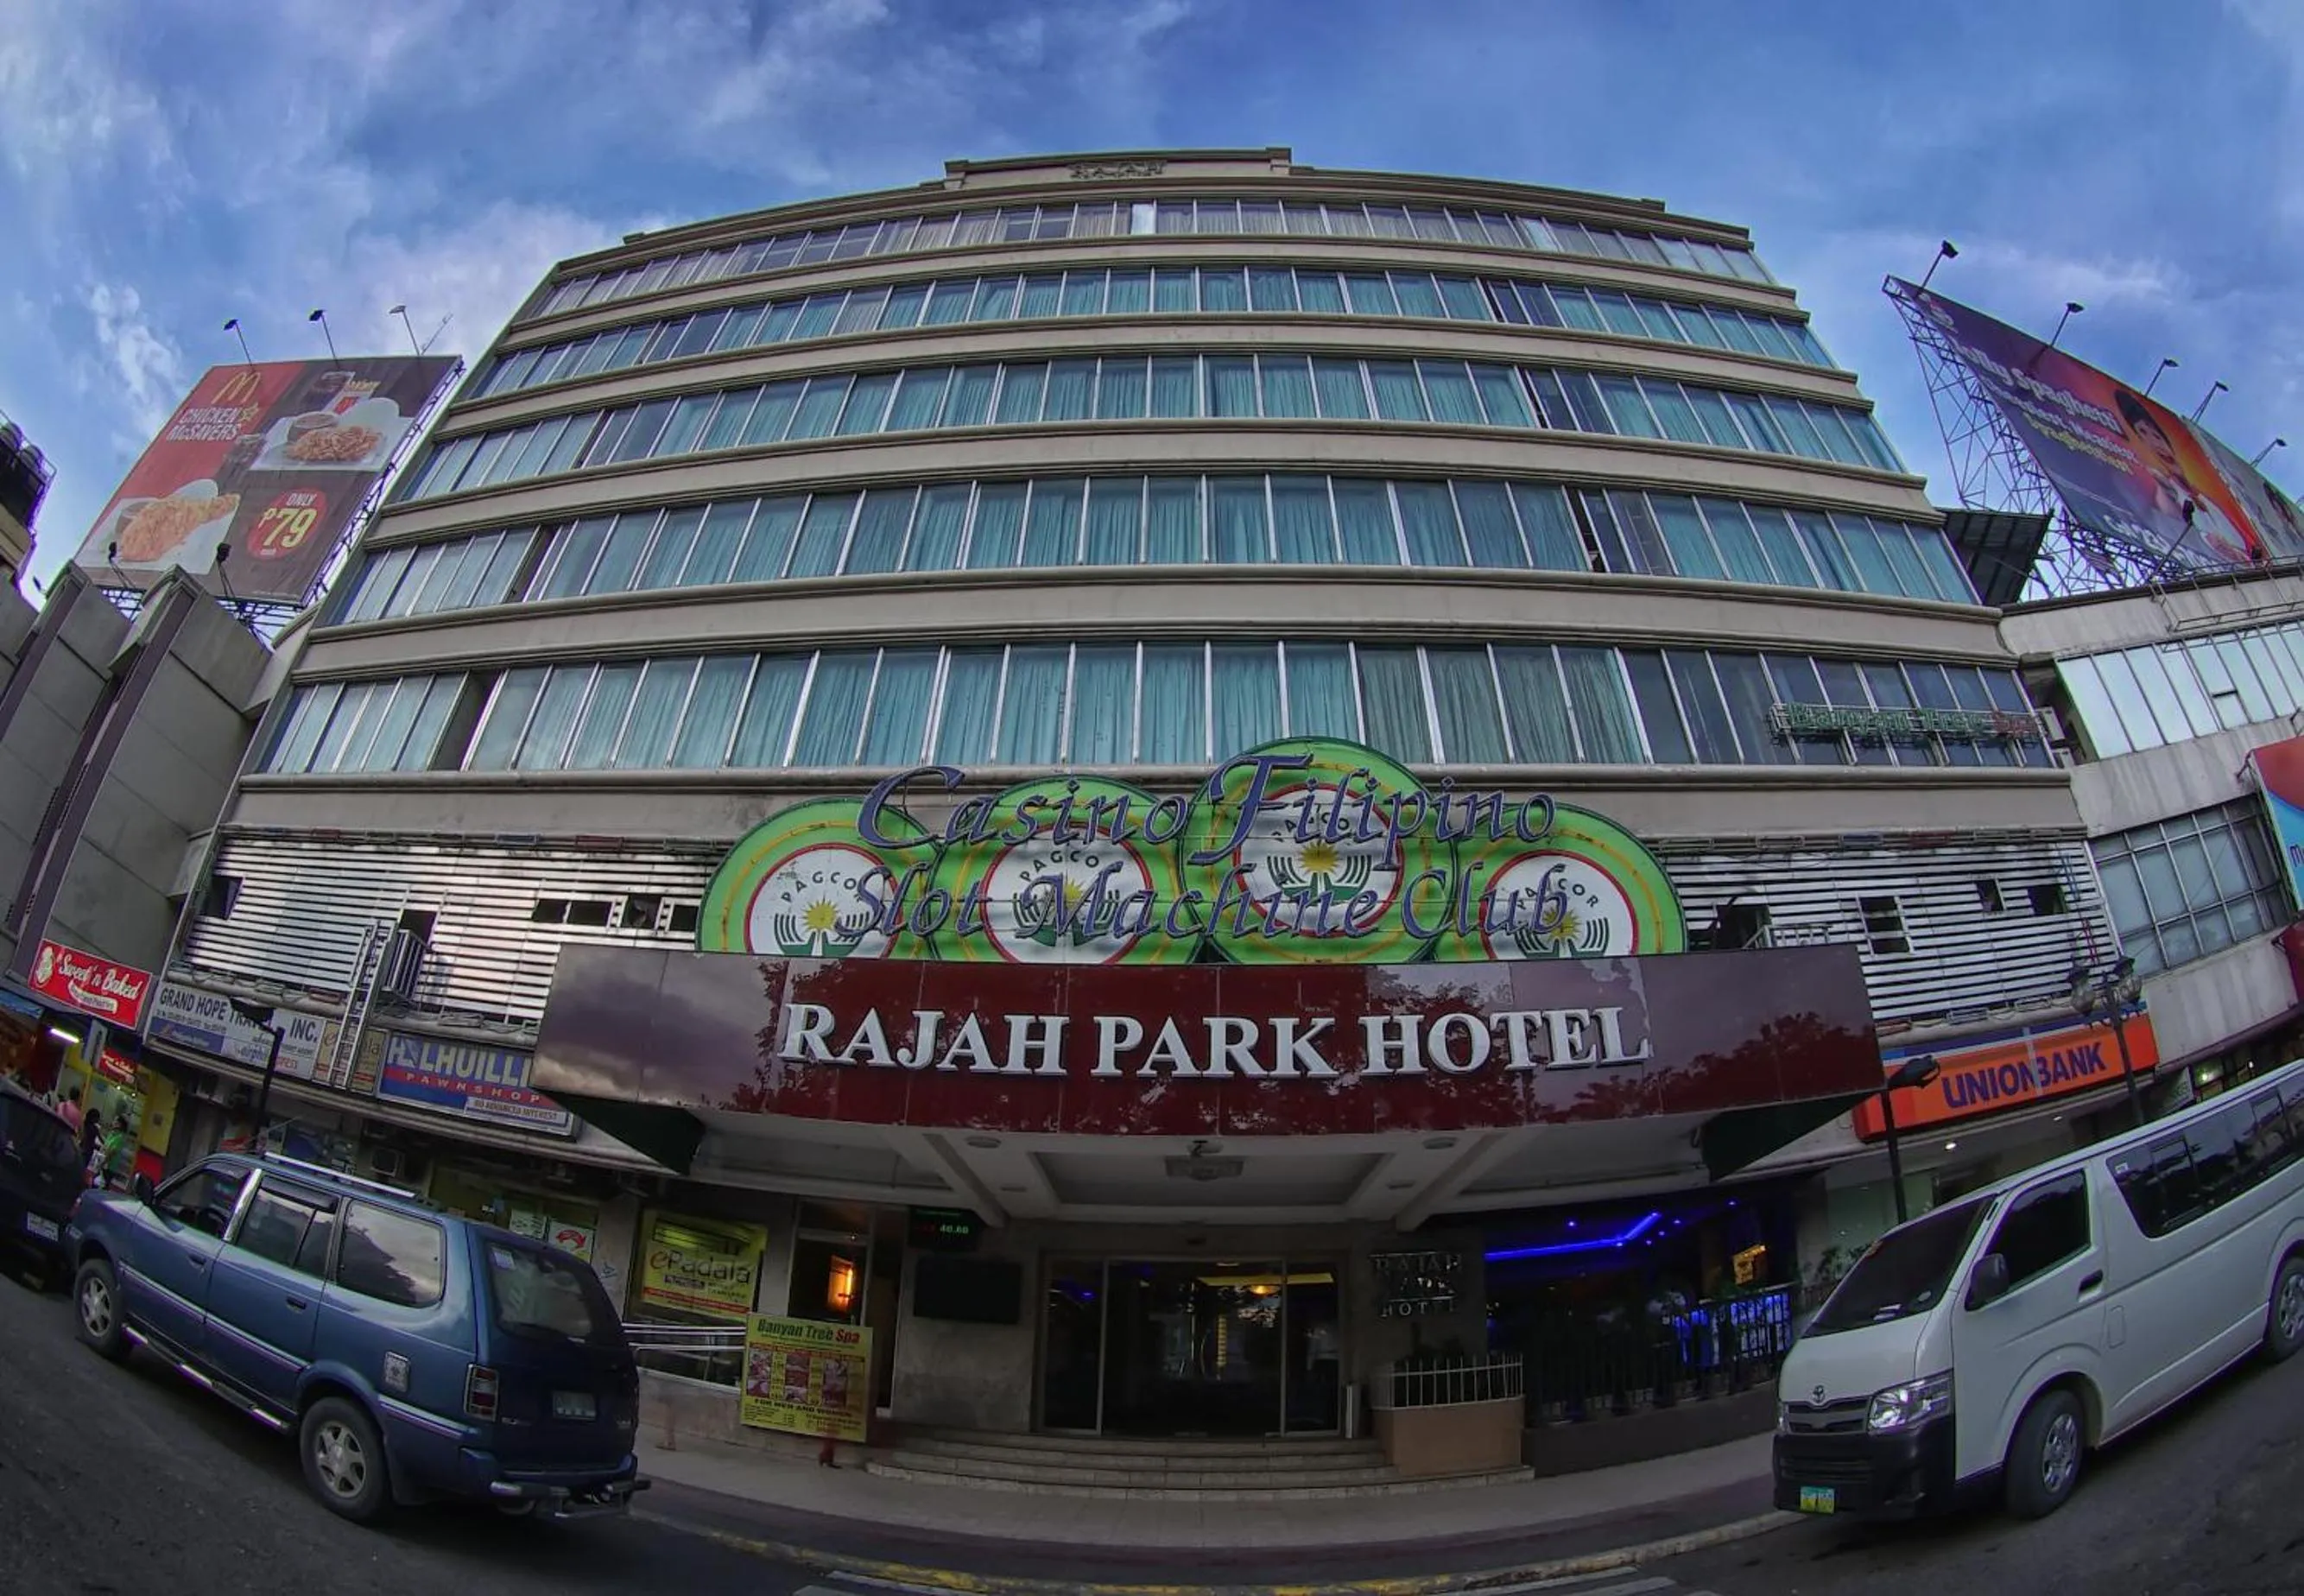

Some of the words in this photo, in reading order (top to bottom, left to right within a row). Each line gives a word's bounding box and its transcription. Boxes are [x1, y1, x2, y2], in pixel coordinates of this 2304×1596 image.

[179, 406, 241, 424] CHICKEN
[286, 492, 317, 506] ONLY
[857, 765, 1192, 850] Casino
[1187, 753, 1557, 871] Filipino
[1019, 850, 1100, 882] PAGCO
[834, 860, 993, 936] Slot
[1015, 860, 1380, 940] Machine
[1400, 861, 1568, 940] Club
[101, 967, 143, 1000] Baked
[160, 987, 194, 1012] GRAND
[197, 996, 229, 1020] HOPE
[289, 1016, 318, 1043] INC.
[776, 1002, 1070, 1076] RAJAH
[1090, 1015, 1339, 1078] PARK
[1358, 1006, 1650, 1076] HOTEL
[419, 1042, 534, 1087] LHUILLI
[406, 1072, 541, 1104] PAWNSHOP
[649, 1249, 751, 1284] ePadala
[757, 1318, 804, 1338] Banyan
[807, 1324, 834, 1341] Tree
[835, 1327, 861, 1345] Spa
